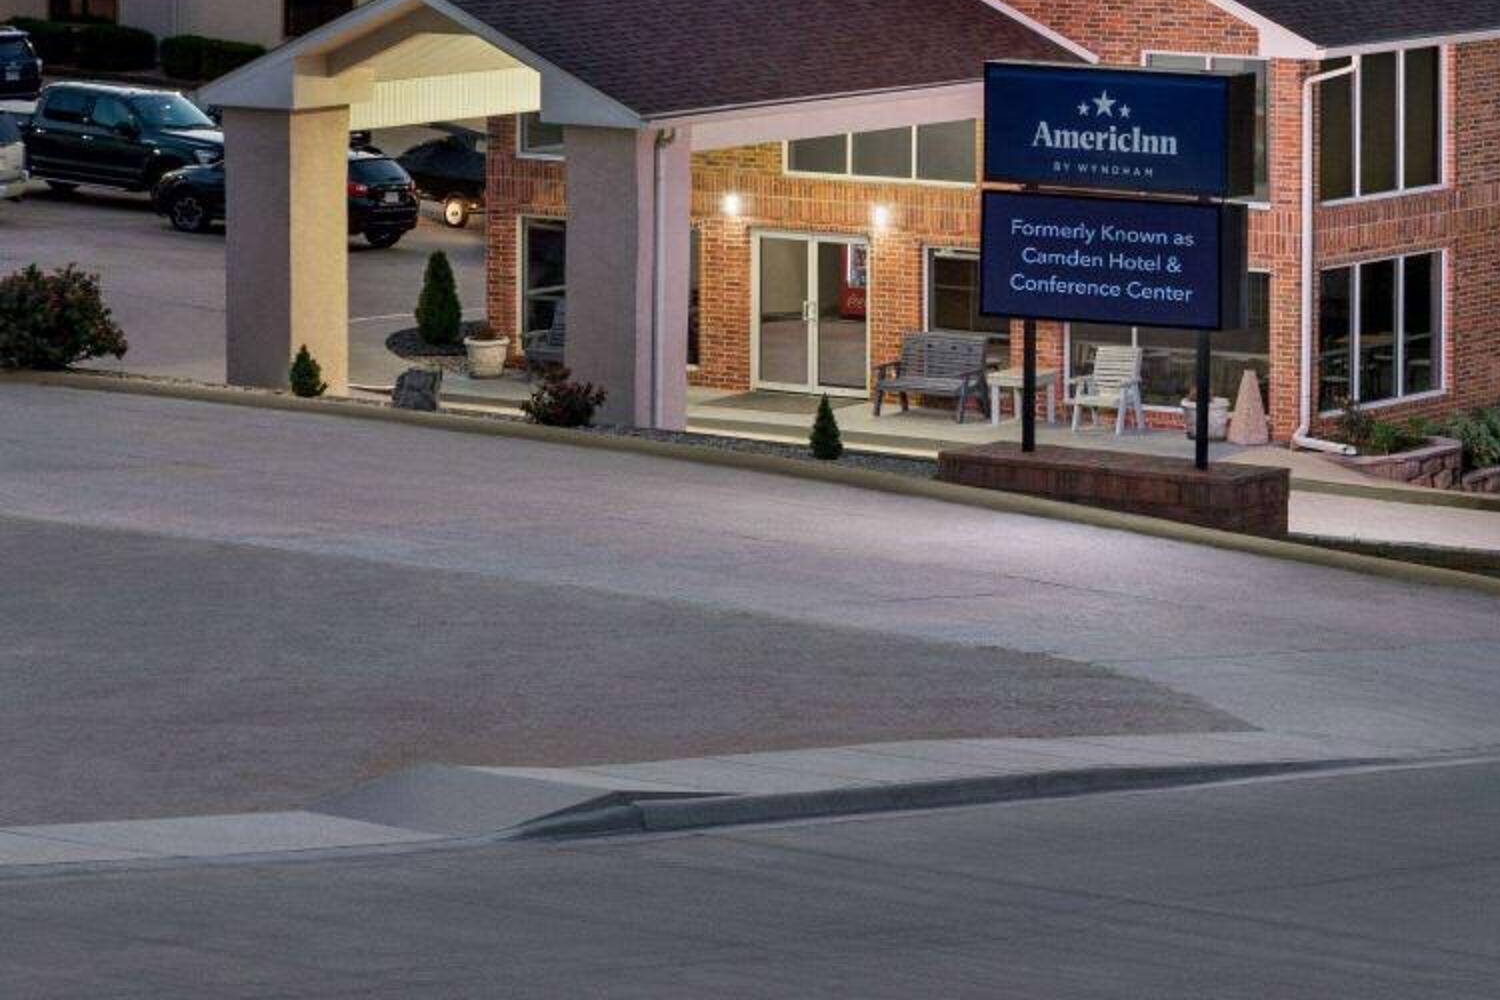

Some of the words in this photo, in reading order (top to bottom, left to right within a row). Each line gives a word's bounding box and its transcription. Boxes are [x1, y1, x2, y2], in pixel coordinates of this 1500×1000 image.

[1032, 121, 1178, 155] AmericInn
[1053, 161, 1071, 172] BY
[1077, 163, 1154, 177] WYNDHAM
[1011, 219, 1096, 244] Formerly
[1101, 225, 1168, 245] Known
[1173, 233, 1195, 247] as
[1021, 247, 1103, 268] Camden
[1109, 253, 1161, 271] Hotel
[1166, 256, 1183, 273] &
[1009, 273, 1121, 297] Conference
[1127, 281, 1194, 302] Center
